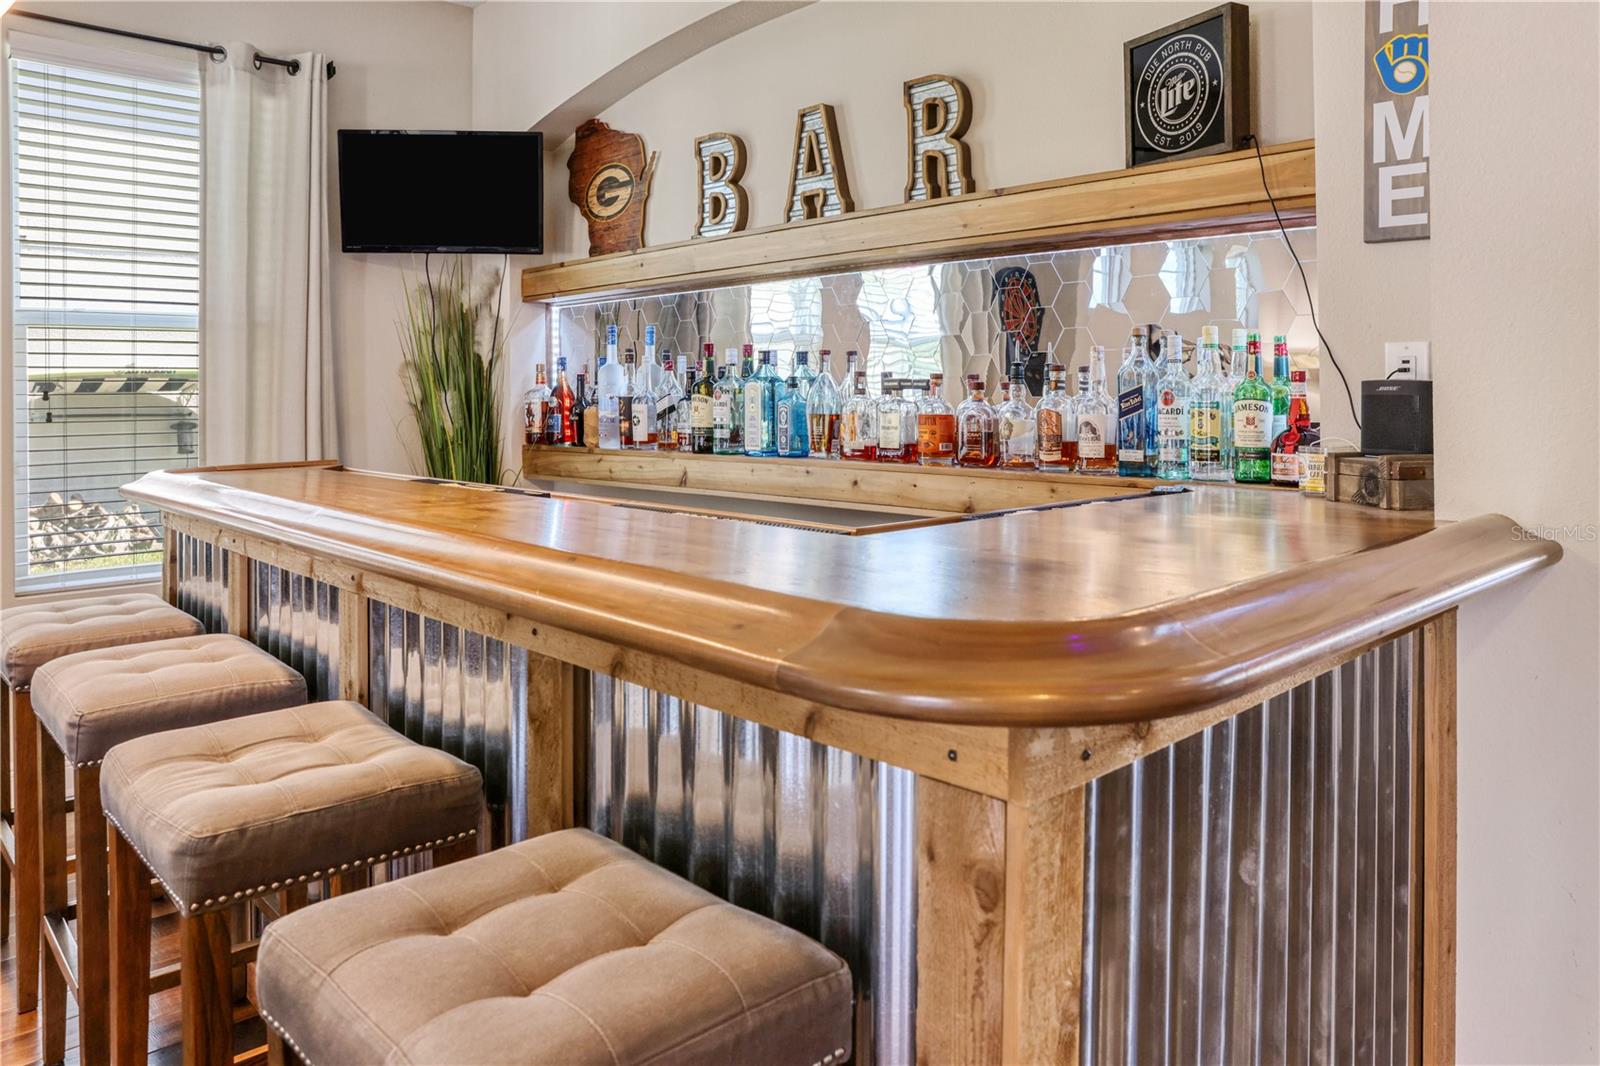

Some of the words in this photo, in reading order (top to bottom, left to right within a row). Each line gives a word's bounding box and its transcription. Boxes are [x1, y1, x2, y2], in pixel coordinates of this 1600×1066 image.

[1144, 58, 1160, 81] DUE
[1161, 40, 1192, 59] NORTH
[1195, 43, 1212, 62] PUB
[1160, 78, 1195, 118] Lite
[1154, 133, 1174, 147] EST.
[1179, 122, 1203, 145] 2019
[692, 74, 975, 239] BAR
[1235, 403, 1269, 413] JAMESON
